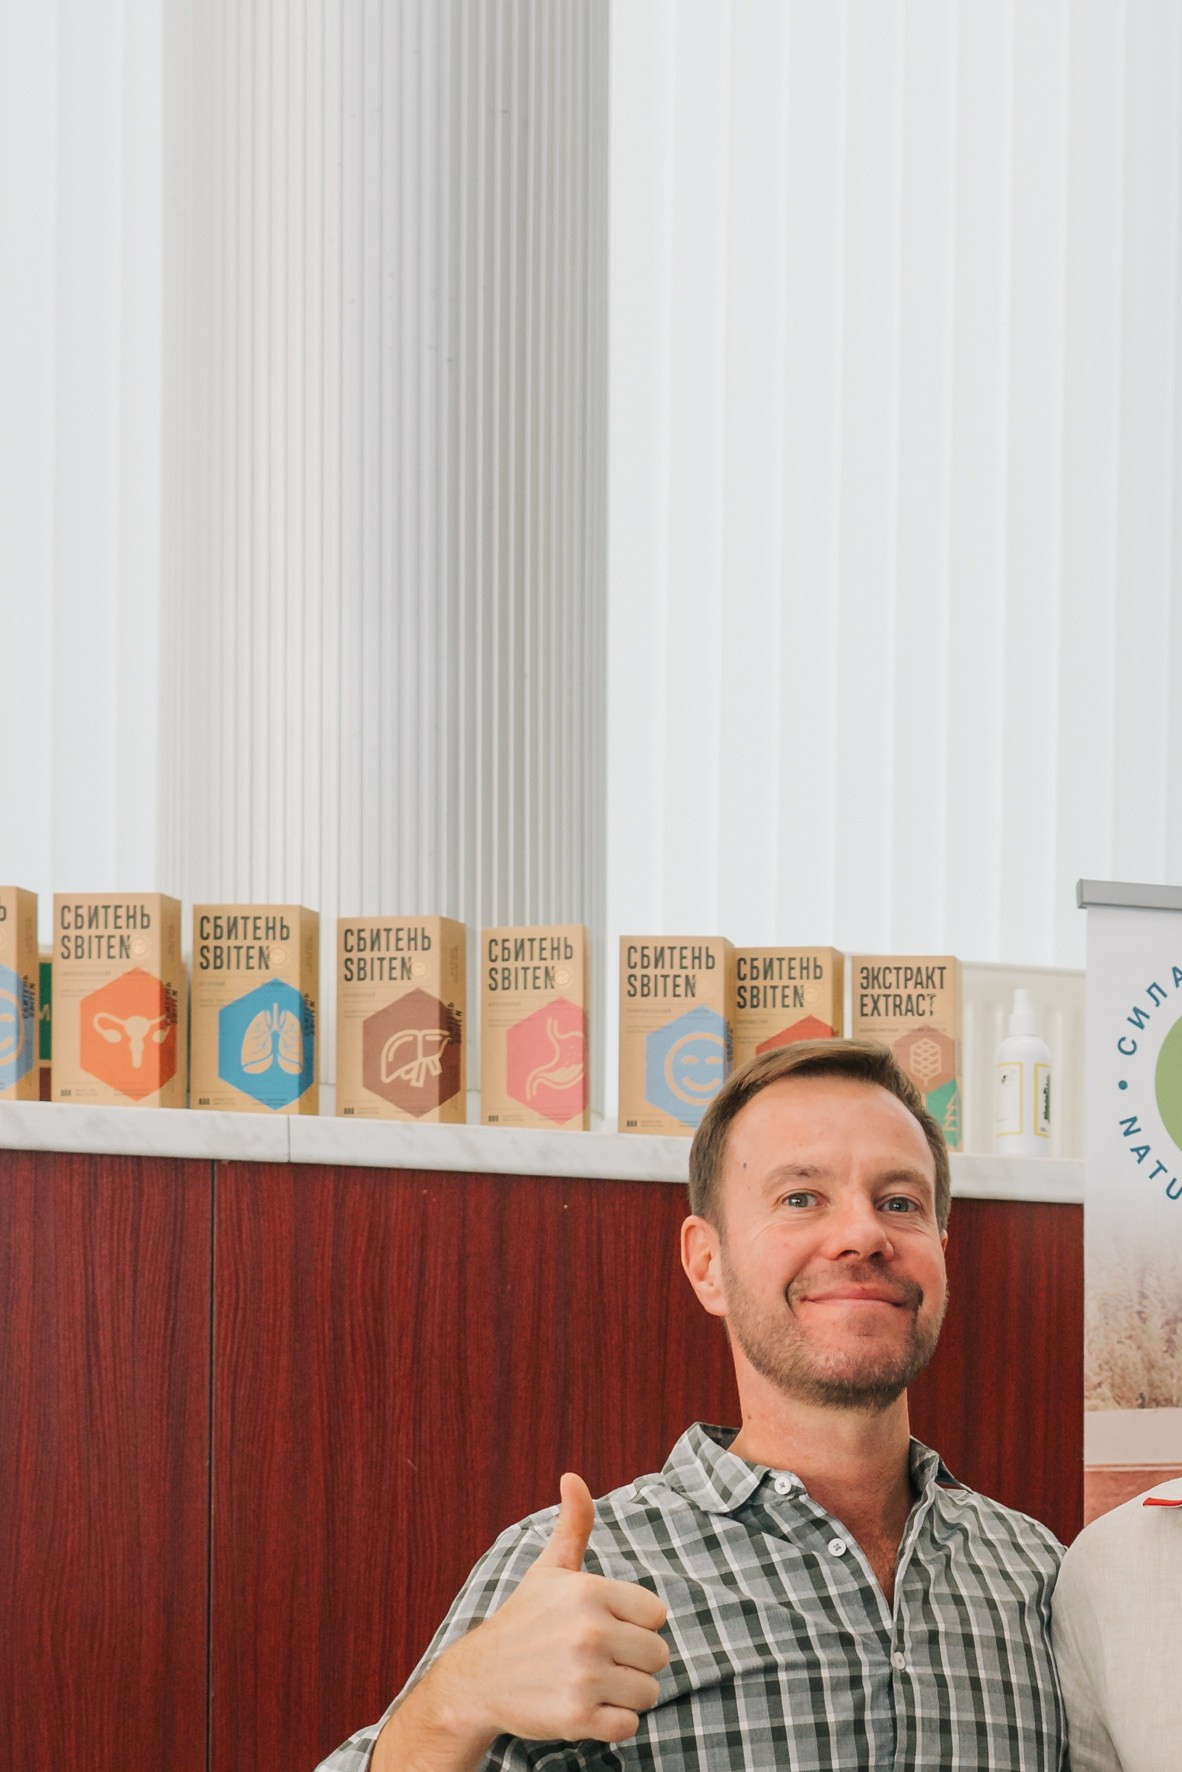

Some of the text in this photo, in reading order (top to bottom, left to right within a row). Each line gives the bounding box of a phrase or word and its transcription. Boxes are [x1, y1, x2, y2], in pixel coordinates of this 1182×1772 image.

[61, 905, 150, 930] СБИТЕНЬ
[200, 916, 290, 941] СБИТЕНЬ
[61, 935, 130, 959] SBITEN
[344, 927, 431, 952] СБИТЕНЬ
[488, 936, 574, 964] СБИТЕНЬ
[200, 946, 270, 970] SBITEN
[344, 957, 412, 982] SBITEN
[627, 944, 716, 971] СБИТЕНЬ
[737, 956, 823, 981] СБИТЕНЬ
[488, 966, 555, 991] SBITEN
[627, 973, 697, 998] SBITEN
[859, 965, 948, 991] ЭКСТРАКТ
[737, 984, 805, 1009] SBITEN
[859, 993, 935, 1018] EXTRACT
